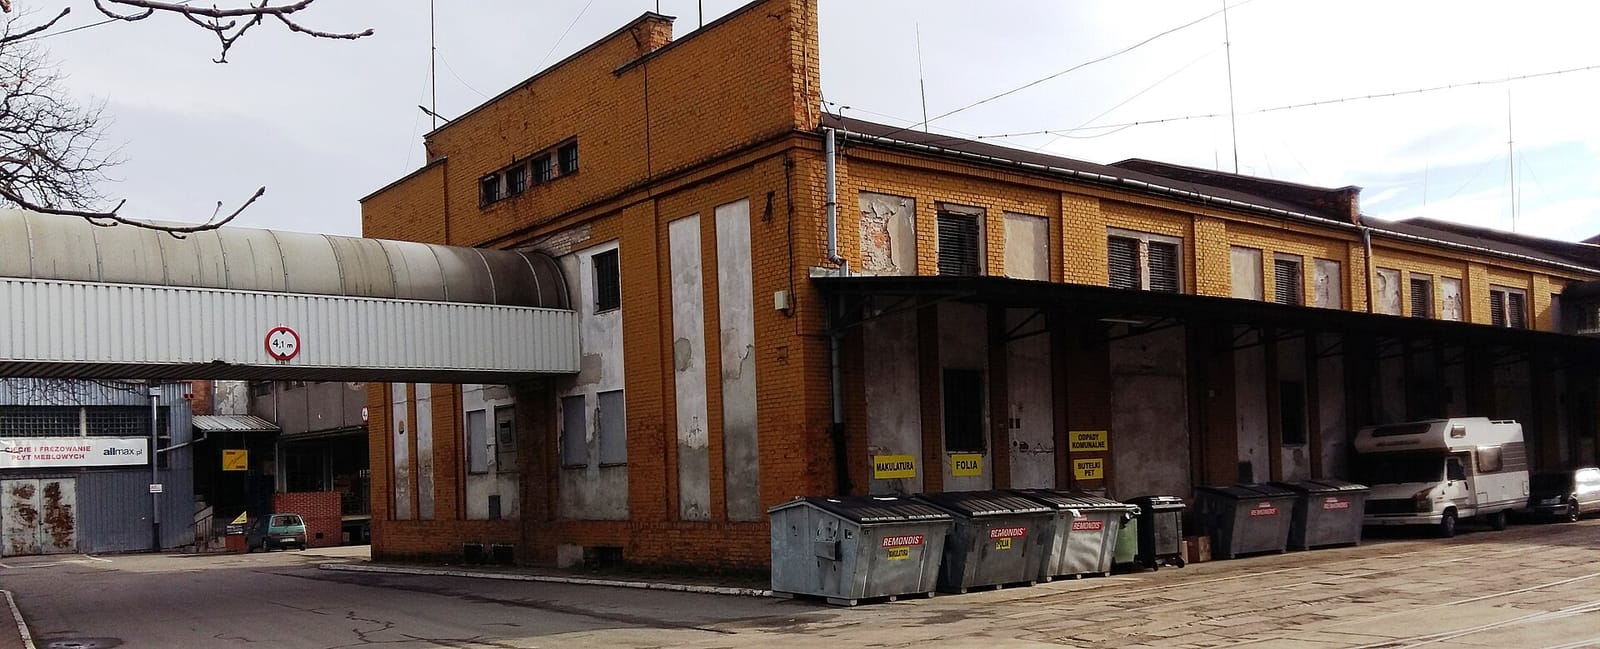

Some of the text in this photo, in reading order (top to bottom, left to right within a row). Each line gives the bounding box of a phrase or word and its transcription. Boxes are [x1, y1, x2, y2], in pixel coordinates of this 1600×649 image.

[272, 339, 285, 349] 4,1
[876, 462, 914, 472] MAKULATURA
[955, 460, 978, 470] FOLIA
[1084, 469, 1095, 477] PET
[990, 528, 1025, 538] REMONDIS
[882, 536, 920, 546] REMONDIS
